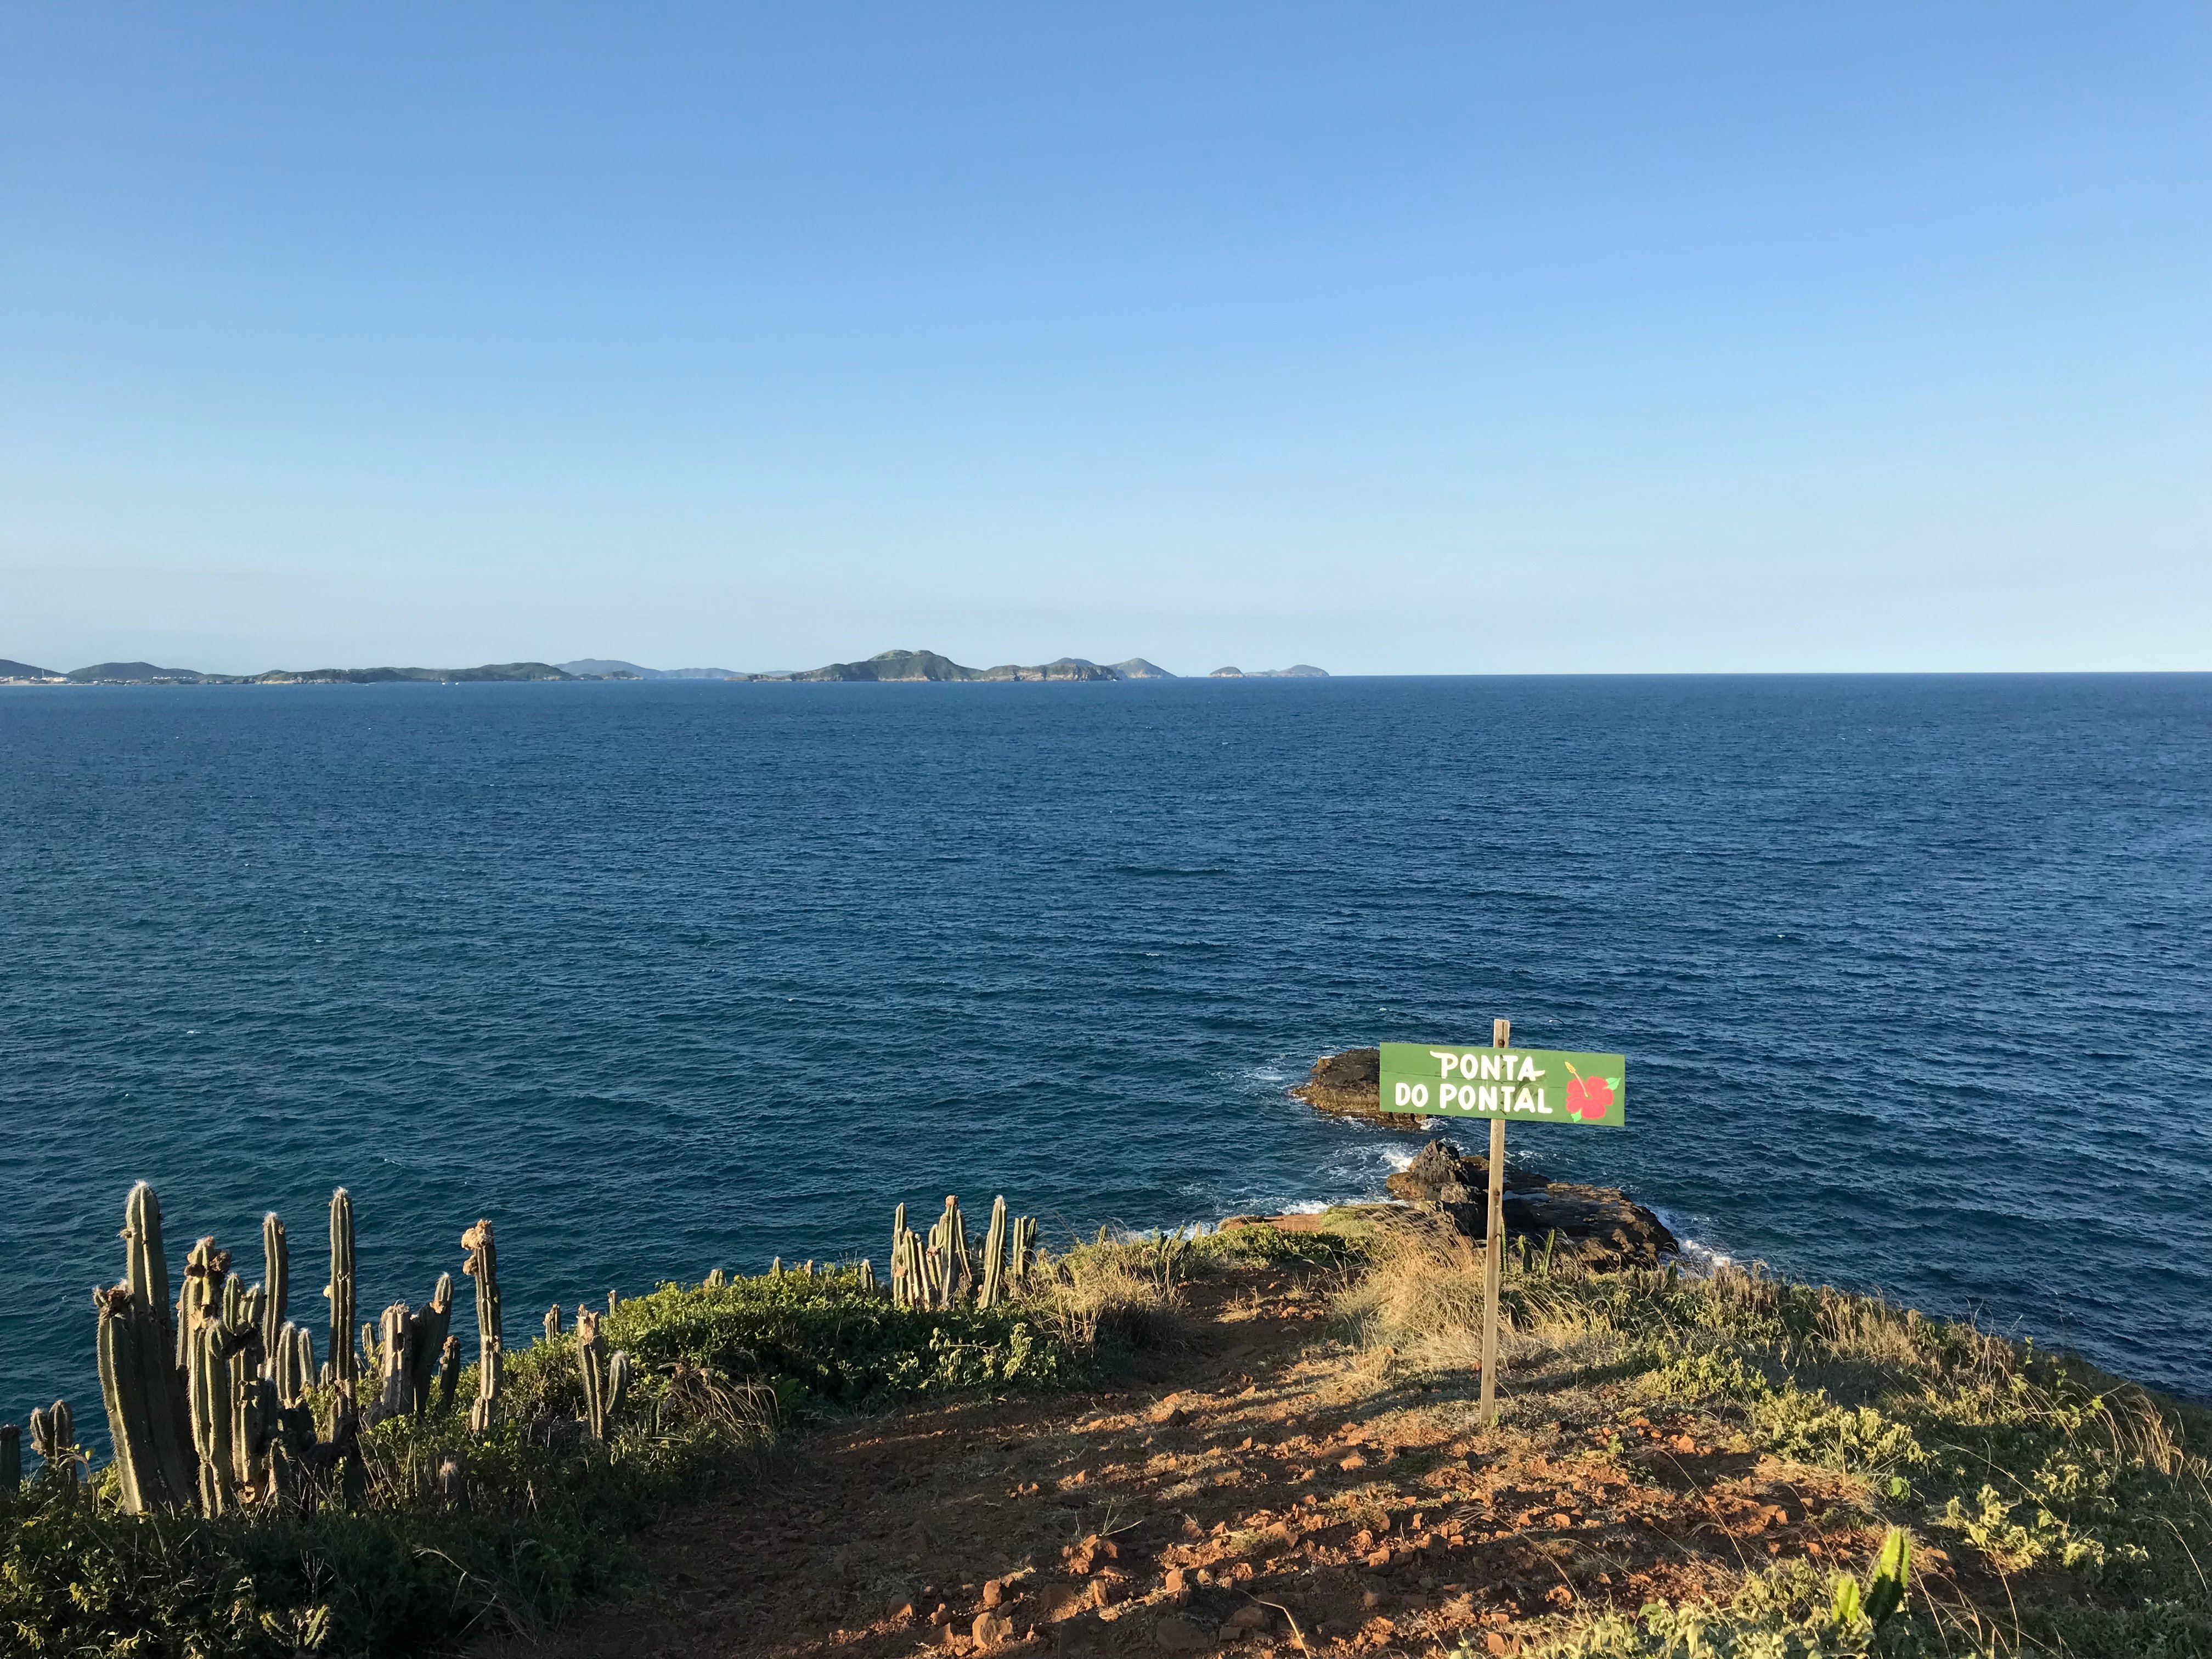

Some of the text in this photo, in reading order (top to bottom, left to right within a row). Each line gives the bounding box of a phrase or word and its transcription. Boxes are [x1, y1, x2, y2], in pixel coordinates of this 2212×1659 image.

[1429, 1050, 1545, 1081] PONTA
[1395, 1082, 1553, 1114] DO PONTAL
